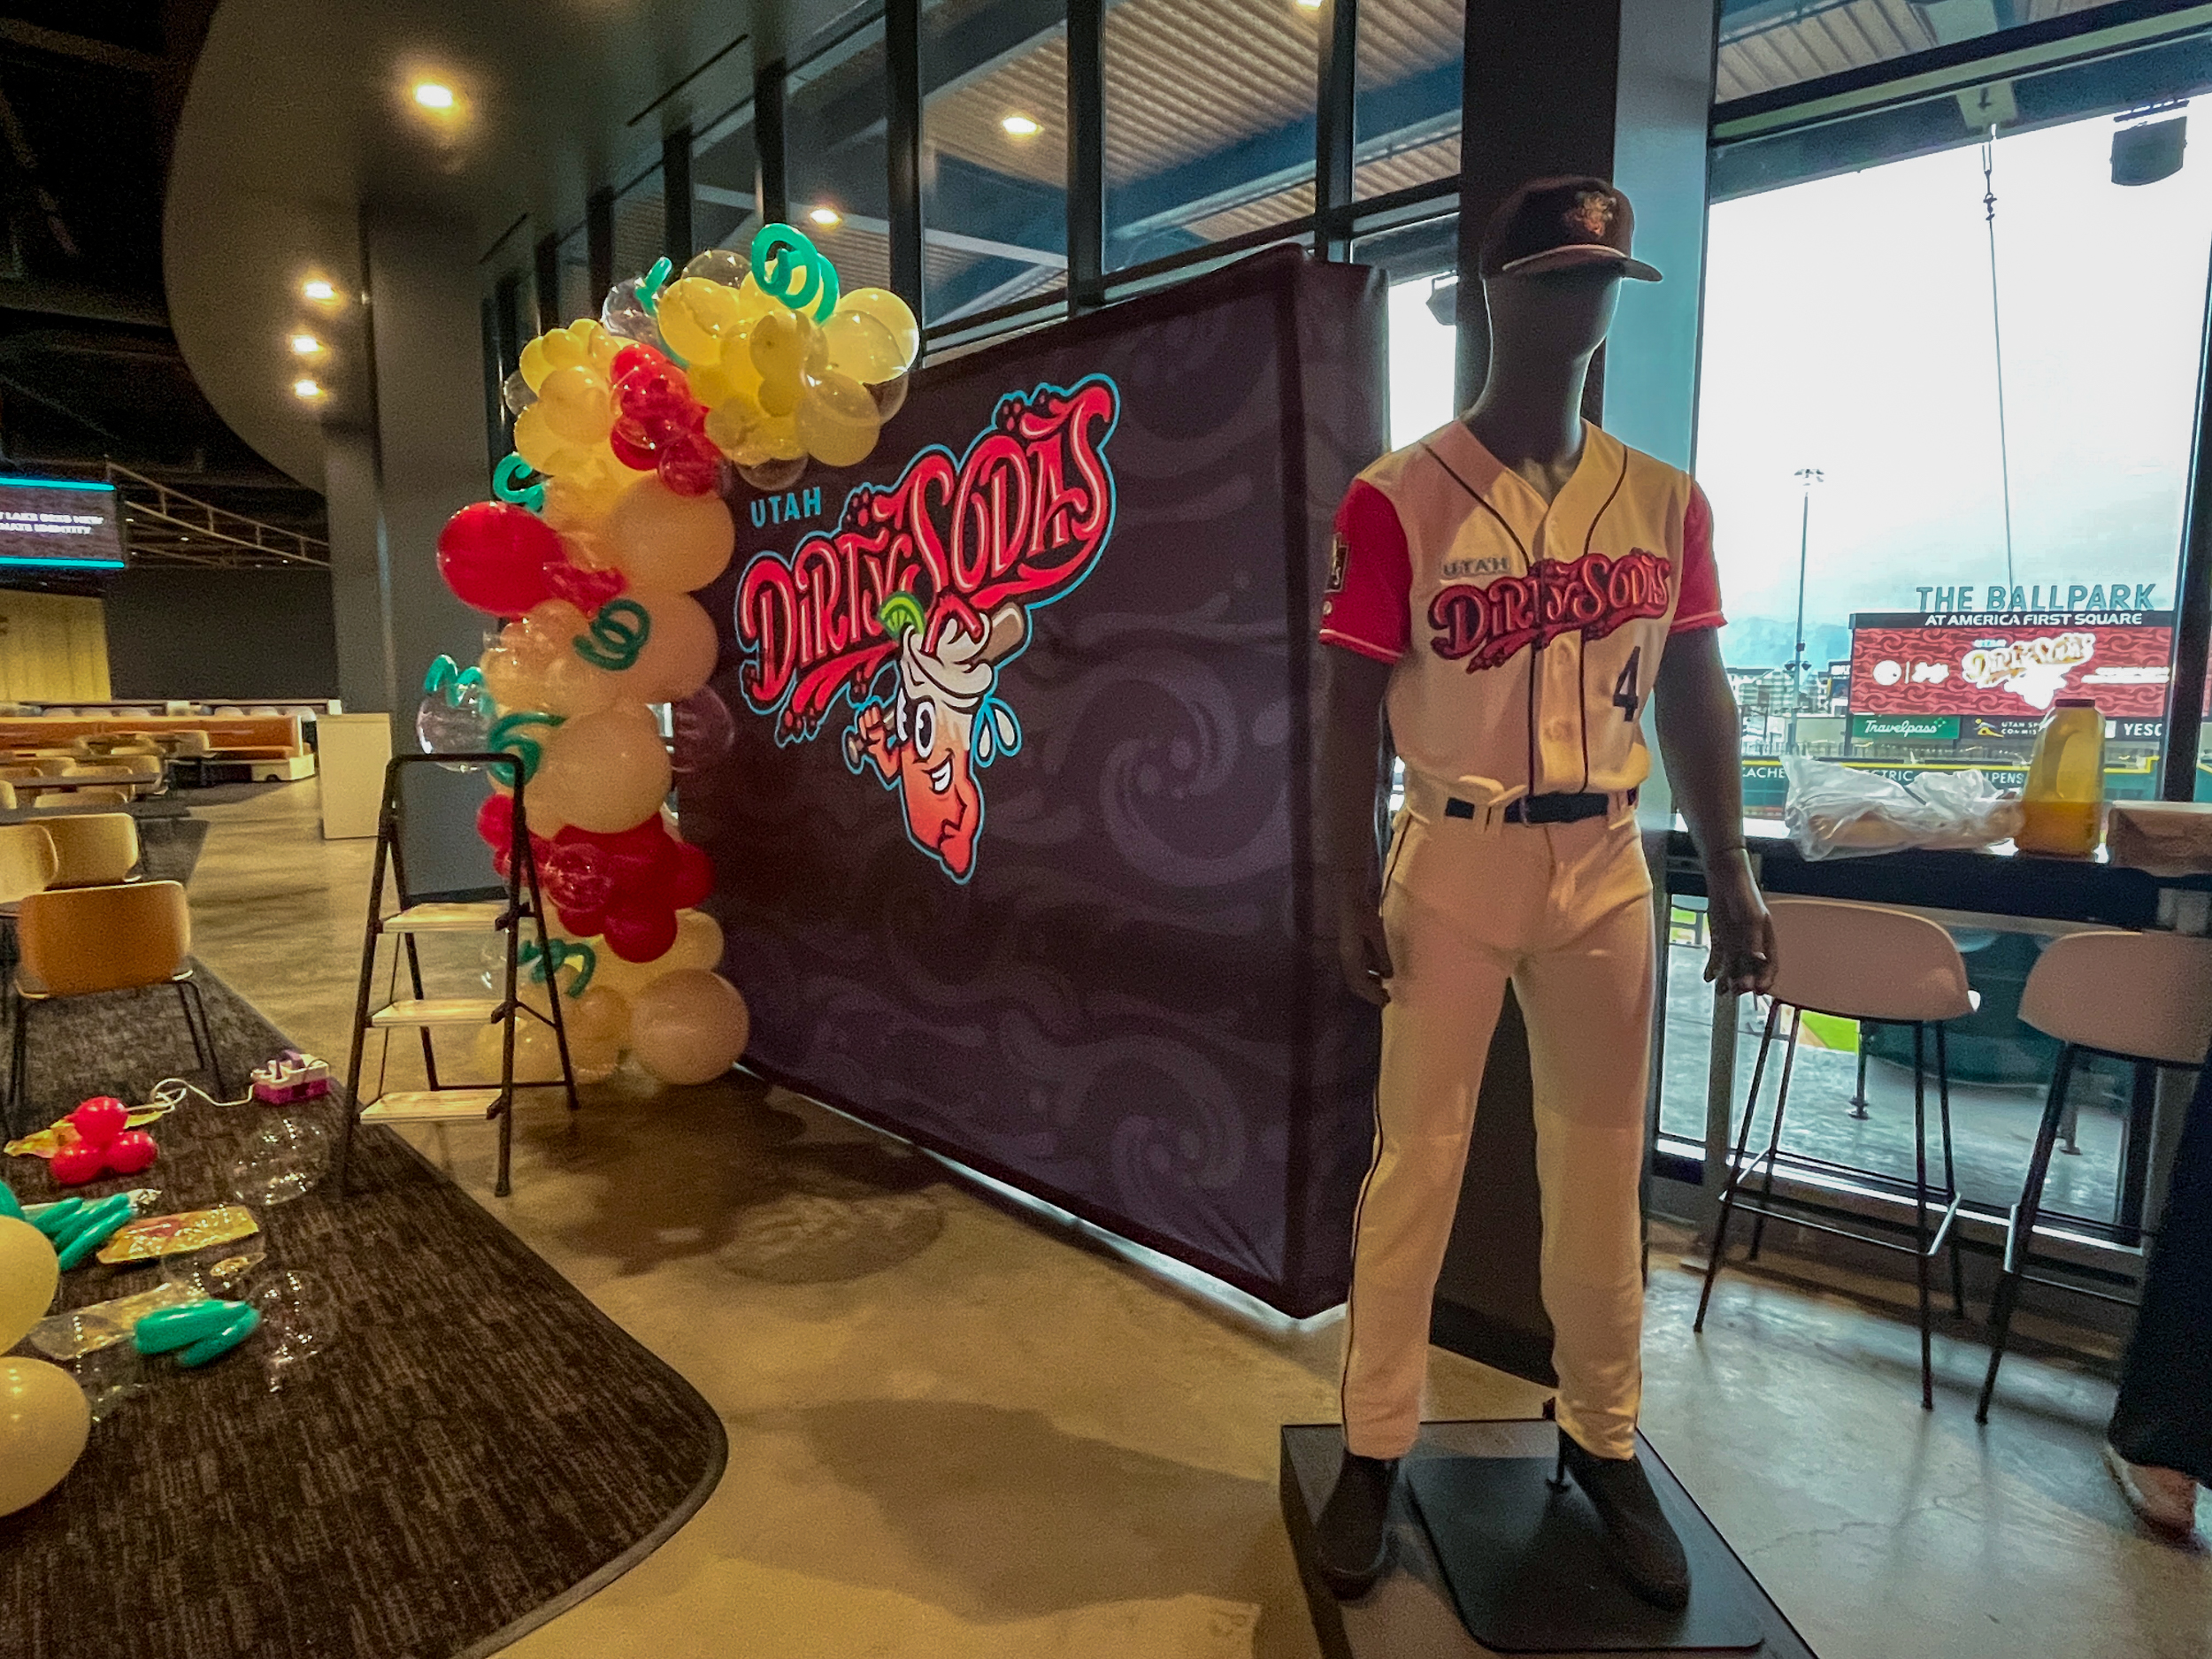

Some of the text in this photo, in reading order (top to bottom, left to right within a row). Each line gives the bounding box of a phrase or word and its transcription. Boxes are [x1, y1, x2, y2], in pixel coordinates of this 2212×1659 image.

[751, 488, 821, 527] UTAH
[1443, 557, 1509, 576] UTAH
[1916, 584, 2156, 612] THE BALLPARK
[1924, 613, 2142, 626] AT AMERICA FIRST SQUARE
[1613, 646, 1640, 722] 4
[1865, 720, 1938, 737] Travelpass
